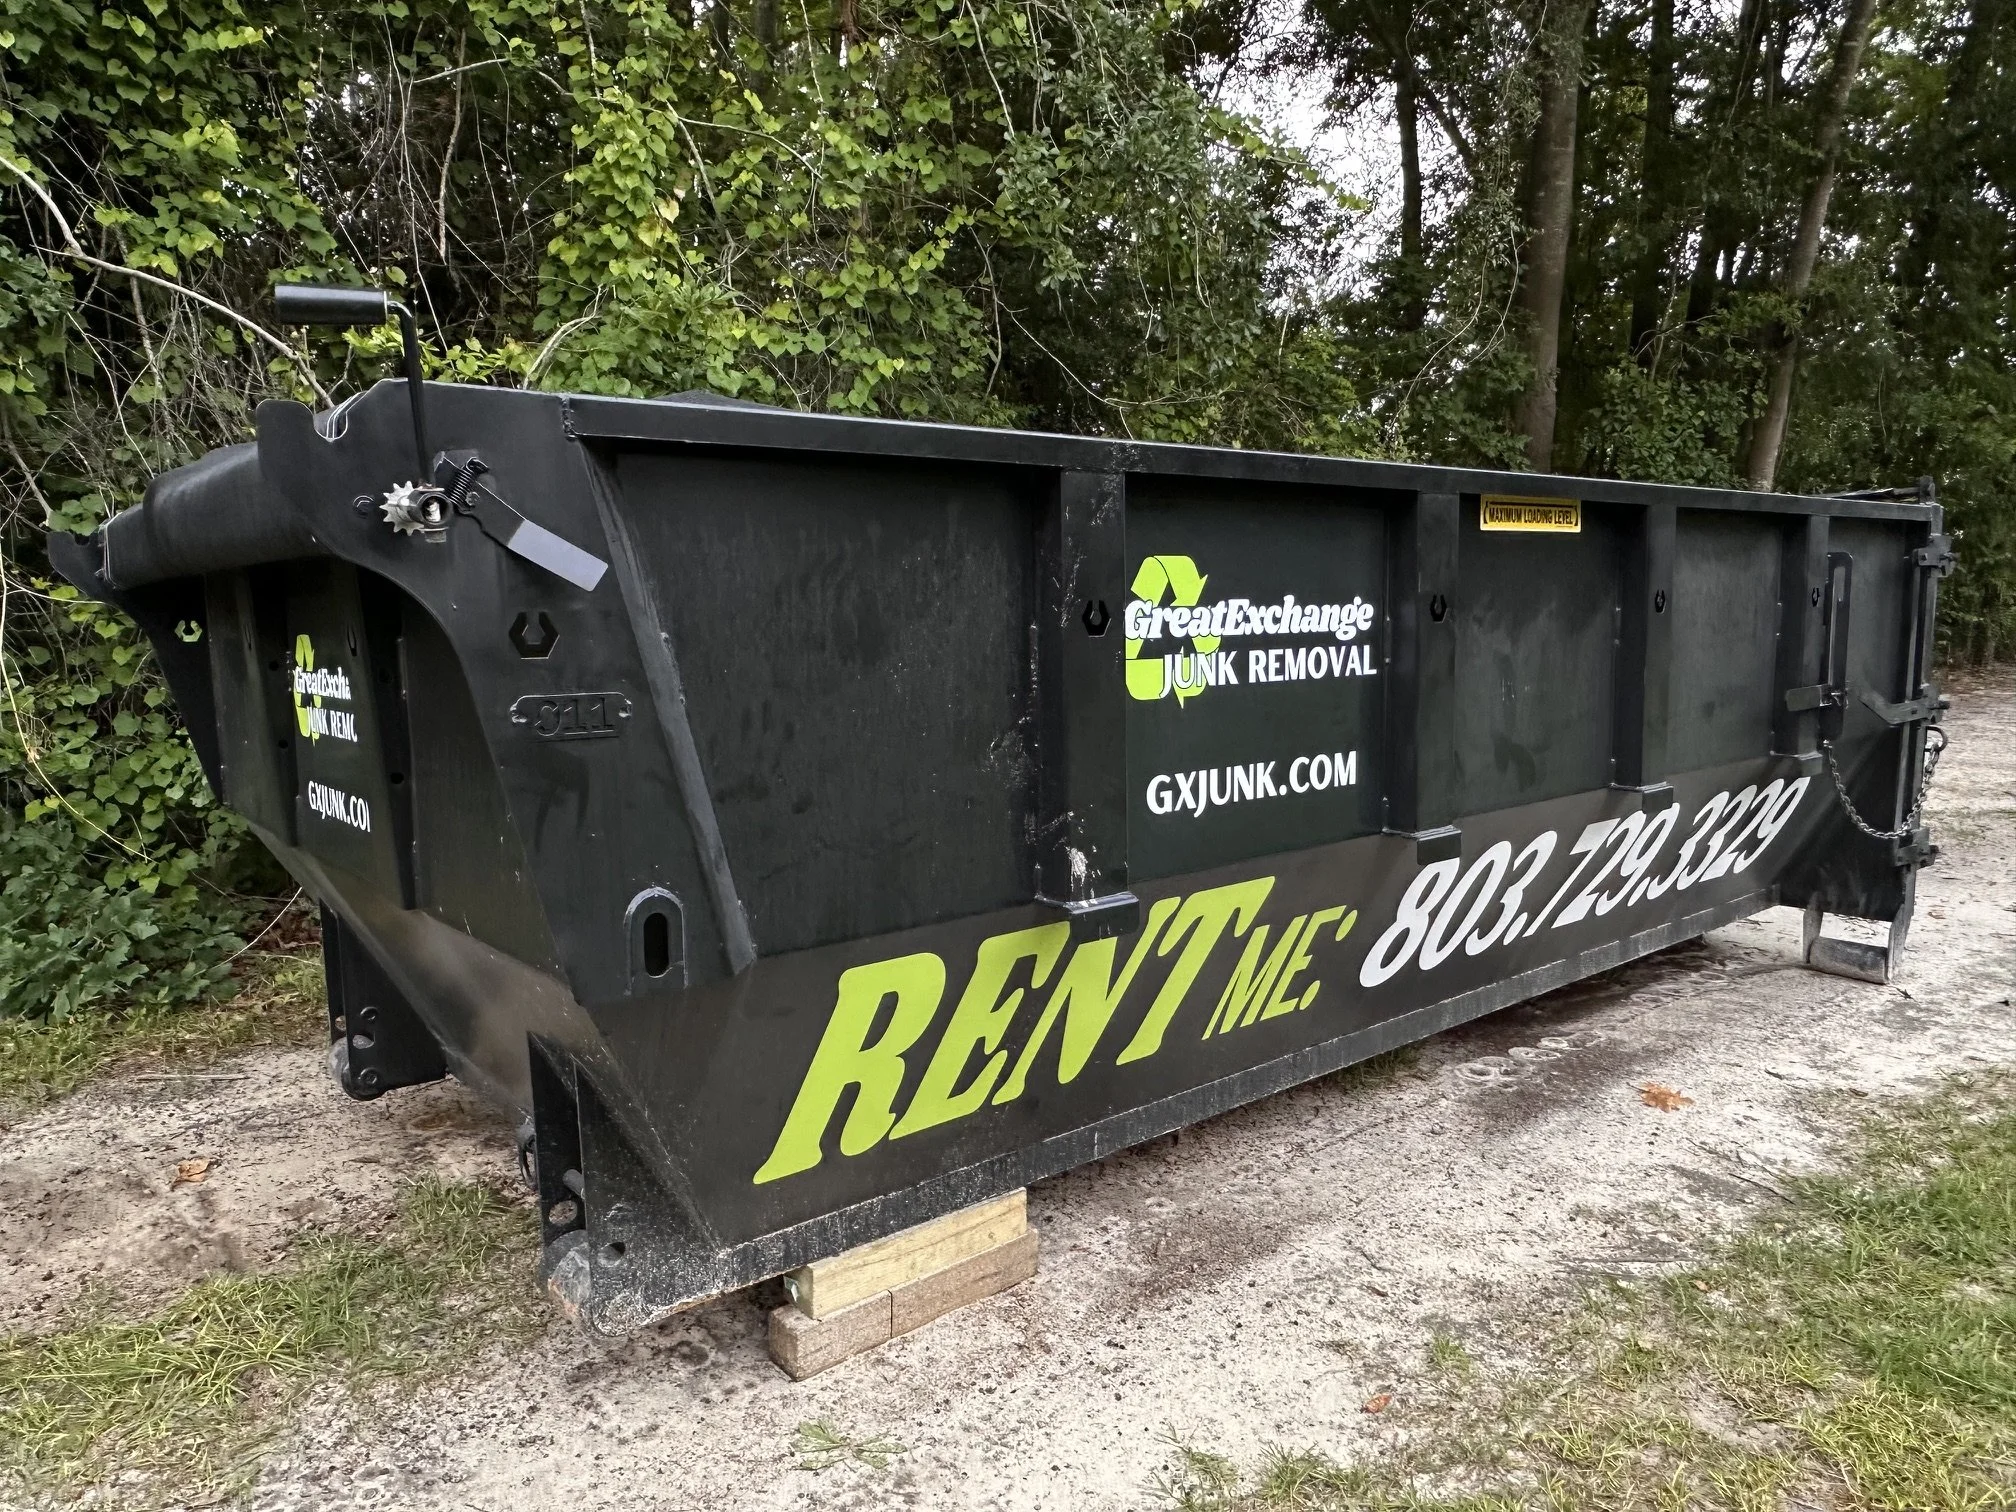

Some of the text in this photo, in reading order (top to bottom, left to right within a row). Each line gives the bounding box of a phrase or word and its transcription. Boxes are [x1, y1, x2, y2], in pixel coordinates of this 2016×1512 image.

[1488, 507, 1574, 525] MAXIMUM LOADING LEVEL
[1124, 594, 1375, 641] GreatExchange
[1159, 644, 1378, 699] JUNK REMOVAL
[1146, 750, 1358, 818] GXJUNK.COM
[1359, 776, 1811, 988] 803.729.3329
[753, 875, 1276, 1185] RENT
